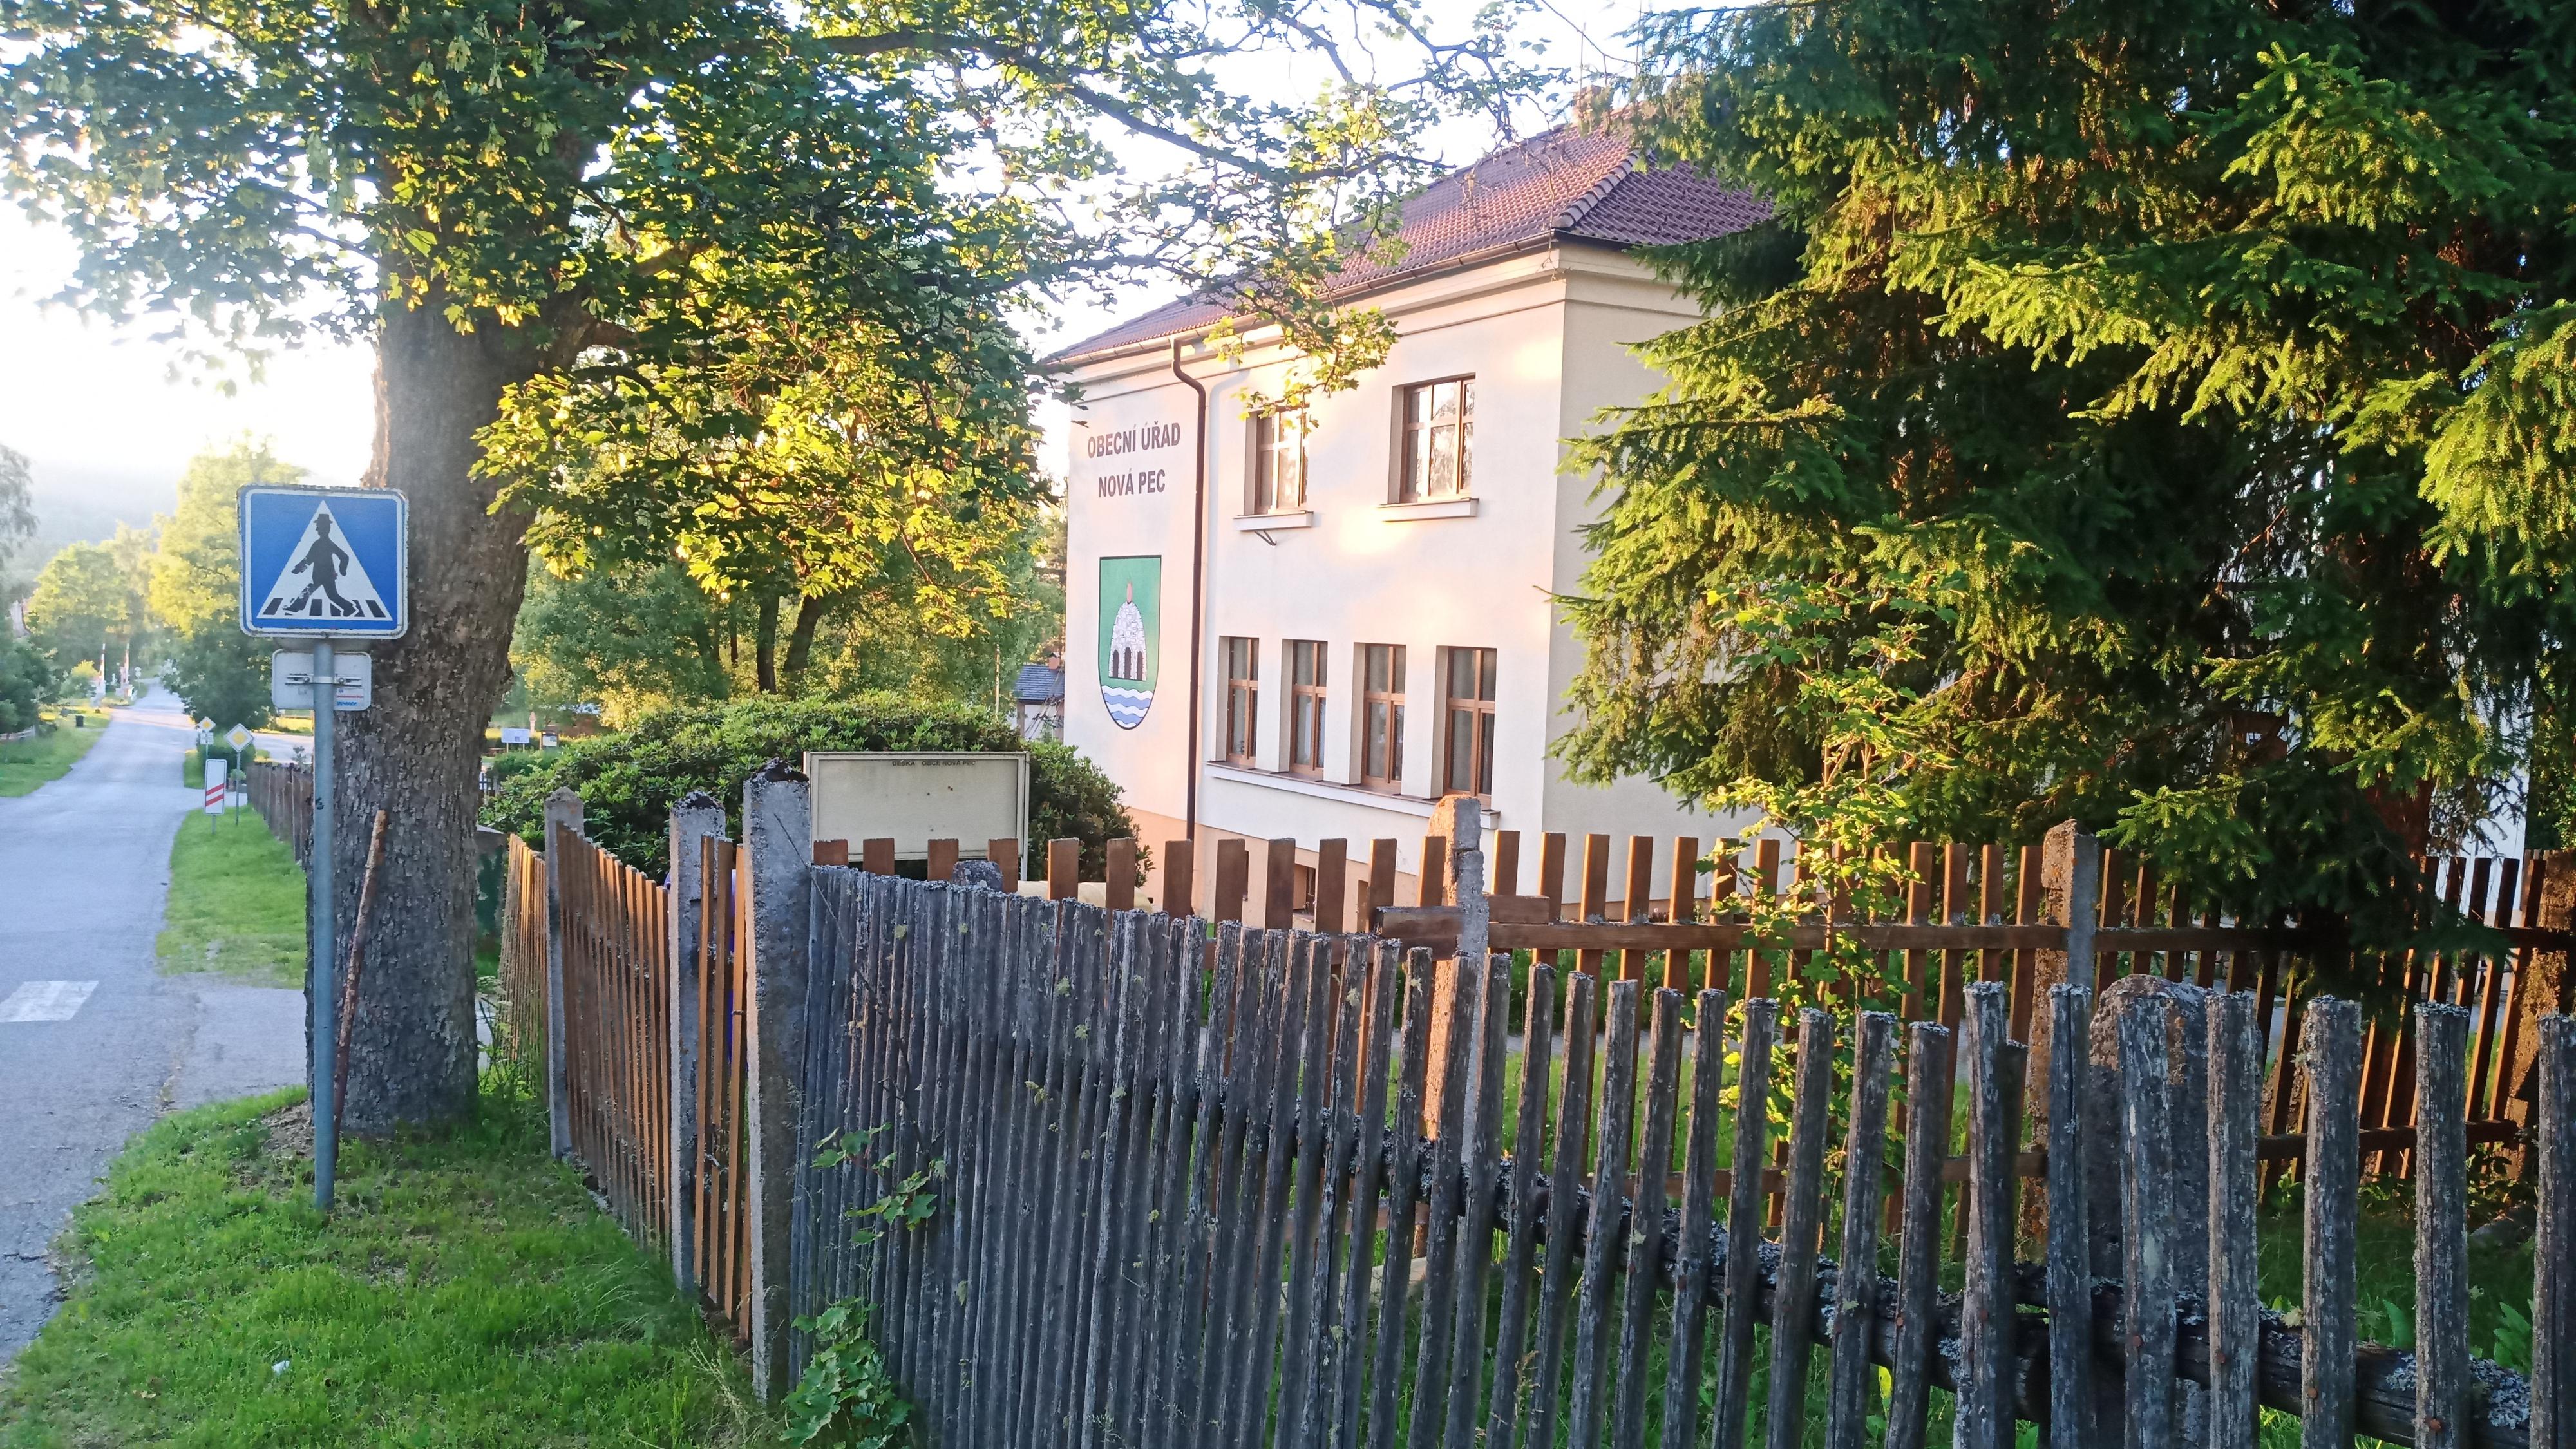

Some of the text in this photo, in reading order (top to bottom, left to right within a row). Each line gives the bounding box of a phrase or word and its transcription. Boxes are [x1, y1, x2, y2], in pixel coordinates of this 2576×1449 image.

[1088, 421, 1180, 458] OBECNÍ ÚŘAD
[1099, 468, 1166, 498] NOVÁ PEC
